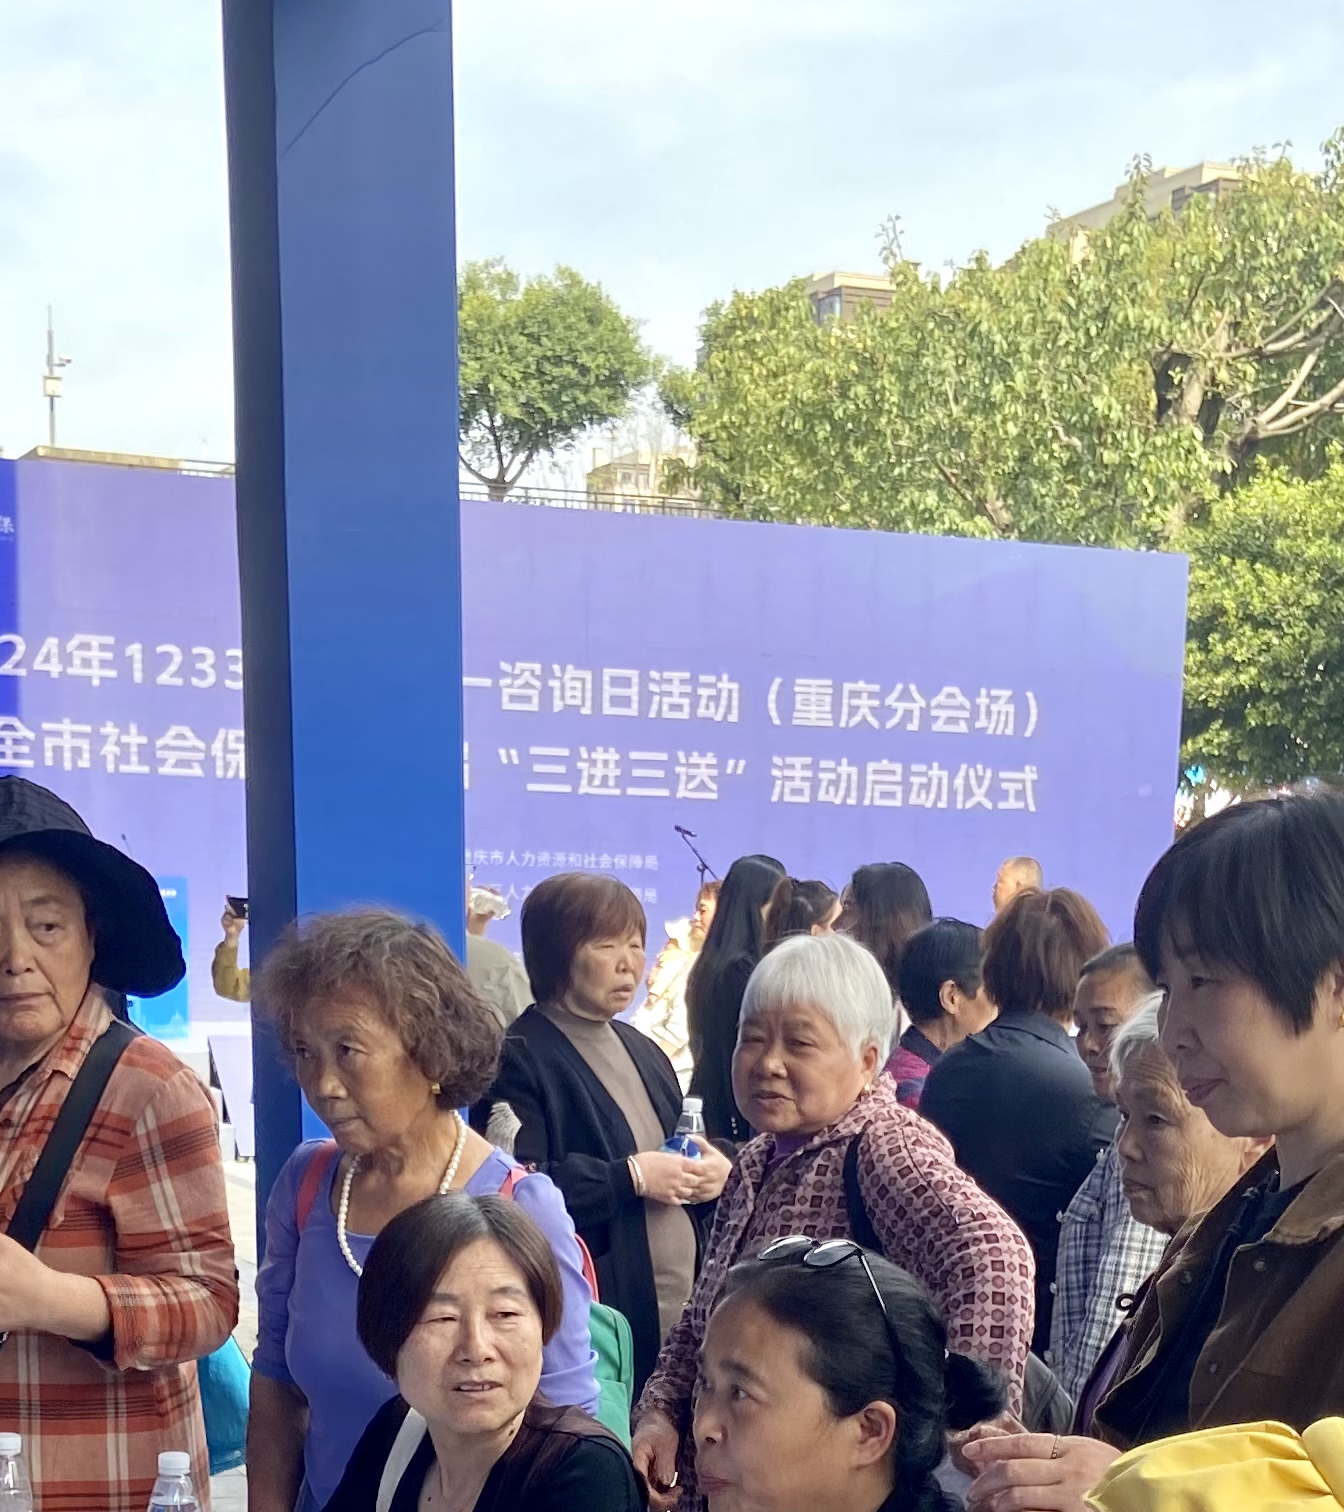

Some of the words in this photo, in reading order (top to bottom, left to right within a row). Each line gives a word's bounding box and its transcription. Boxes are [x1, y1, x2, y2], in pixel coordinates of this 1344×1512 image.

[463, 741, 1040, 813] “三进三送”活动启动仪式
